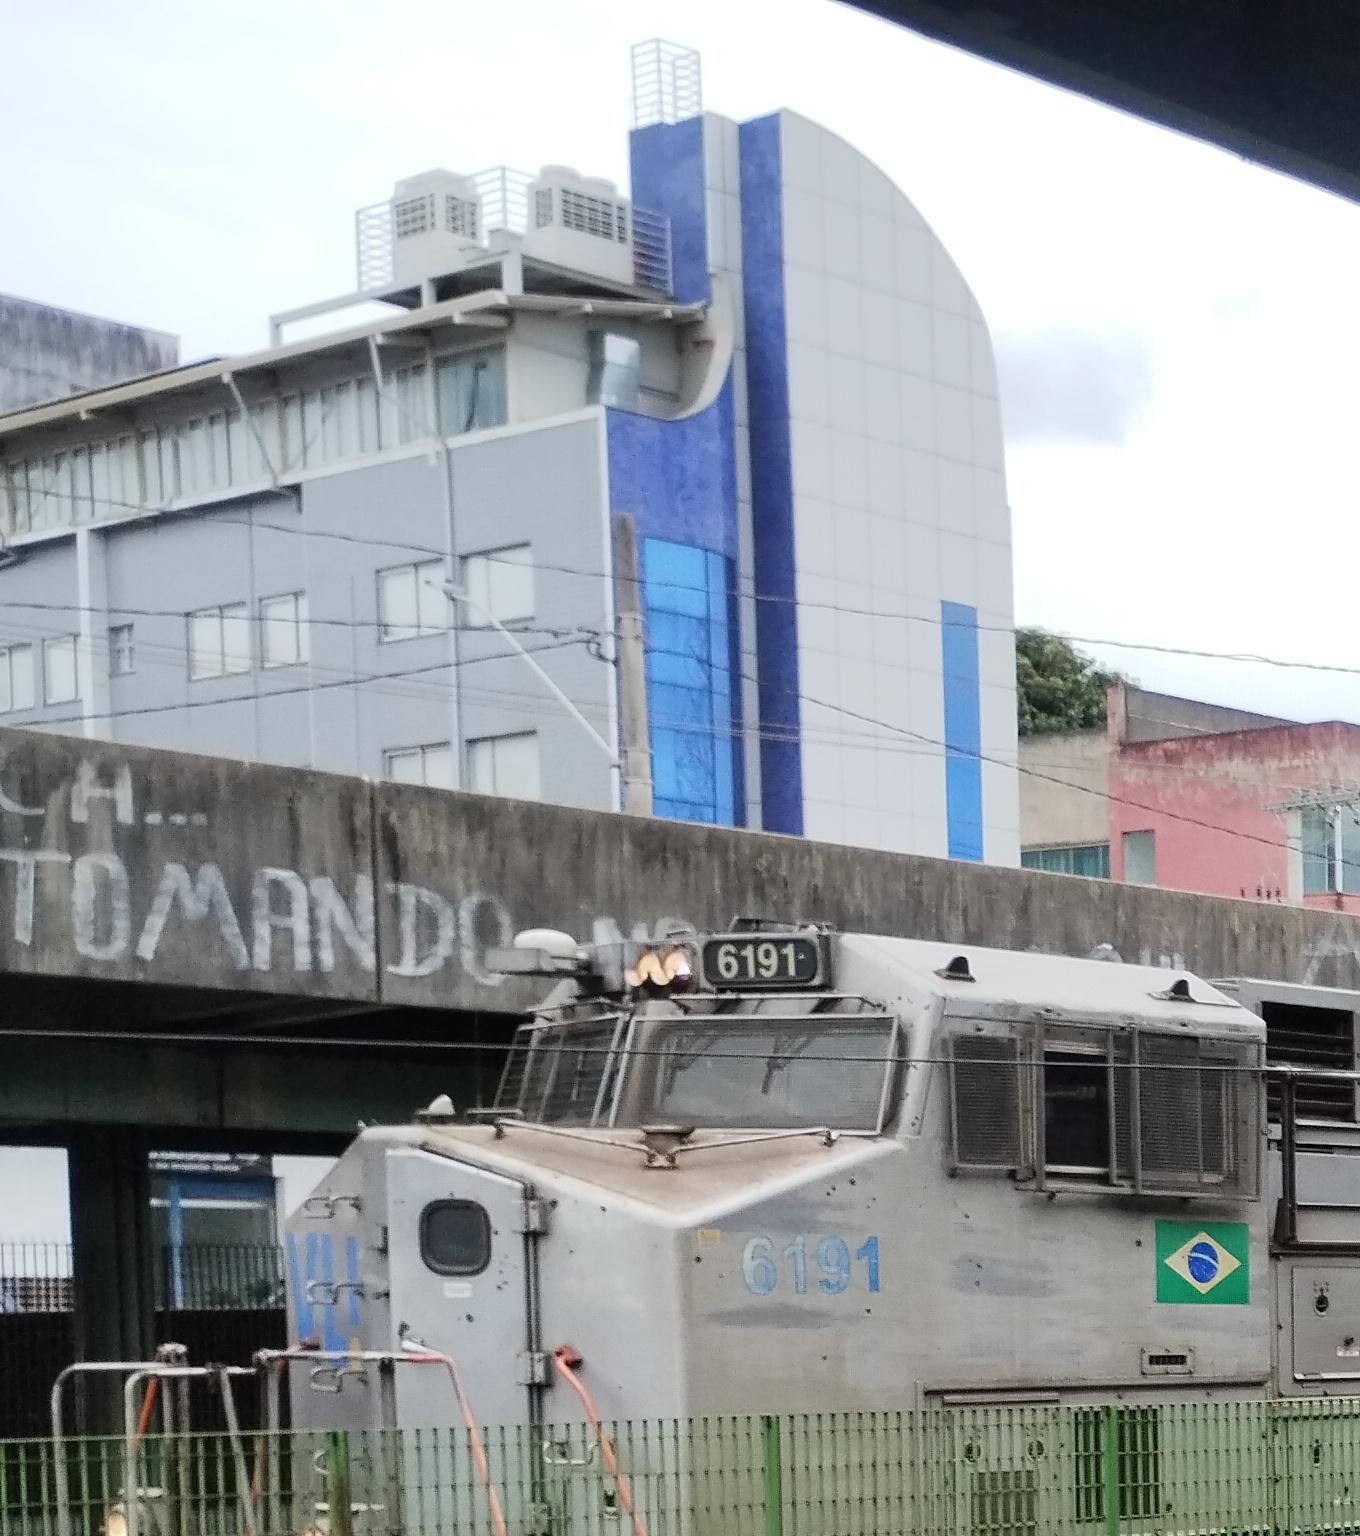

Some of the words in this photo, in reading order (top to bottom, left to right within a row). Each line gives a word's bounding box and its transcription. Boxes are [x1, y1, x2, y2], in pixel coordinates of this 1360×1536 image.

[0, 850, 513, 986] TOMANDO
[717, 943, 796, 979] 6191
[742, 1236, 880, 1295] 6191
